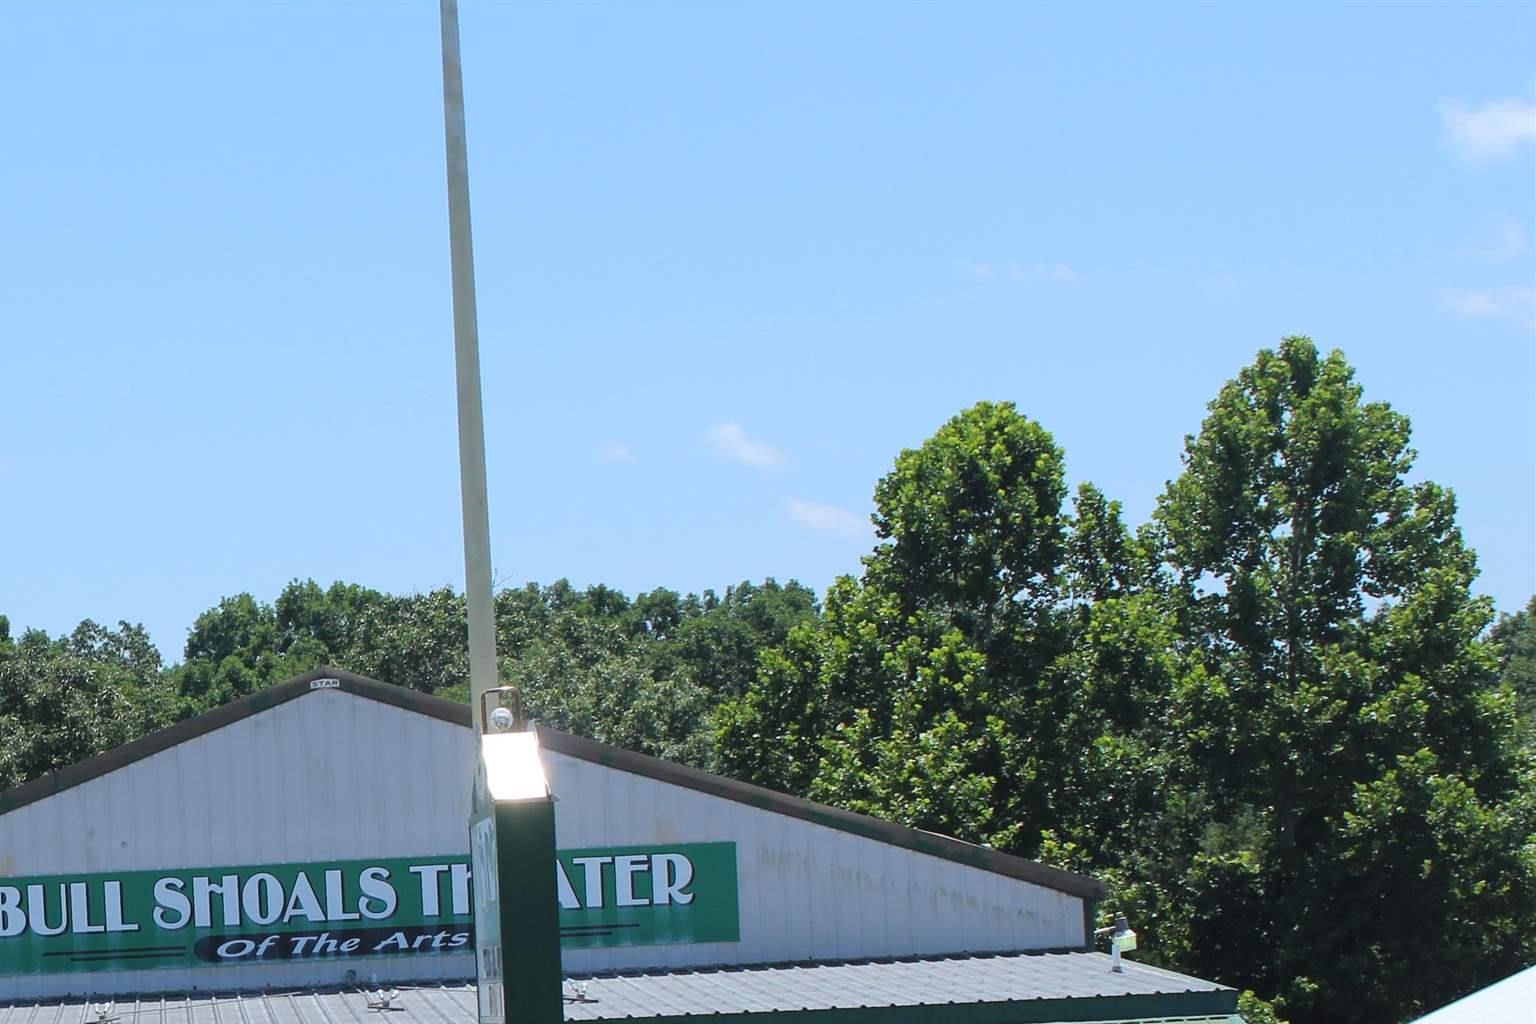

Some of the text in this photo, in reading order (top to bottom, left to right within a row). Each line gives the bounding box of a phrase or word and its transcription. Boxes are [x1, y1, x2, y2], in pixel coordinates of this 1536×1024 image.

[153, 866, 398, 931] SHOALS
[409, 853, 695, 917] TATER
[216, 930, 470, 958] Of The Arts
